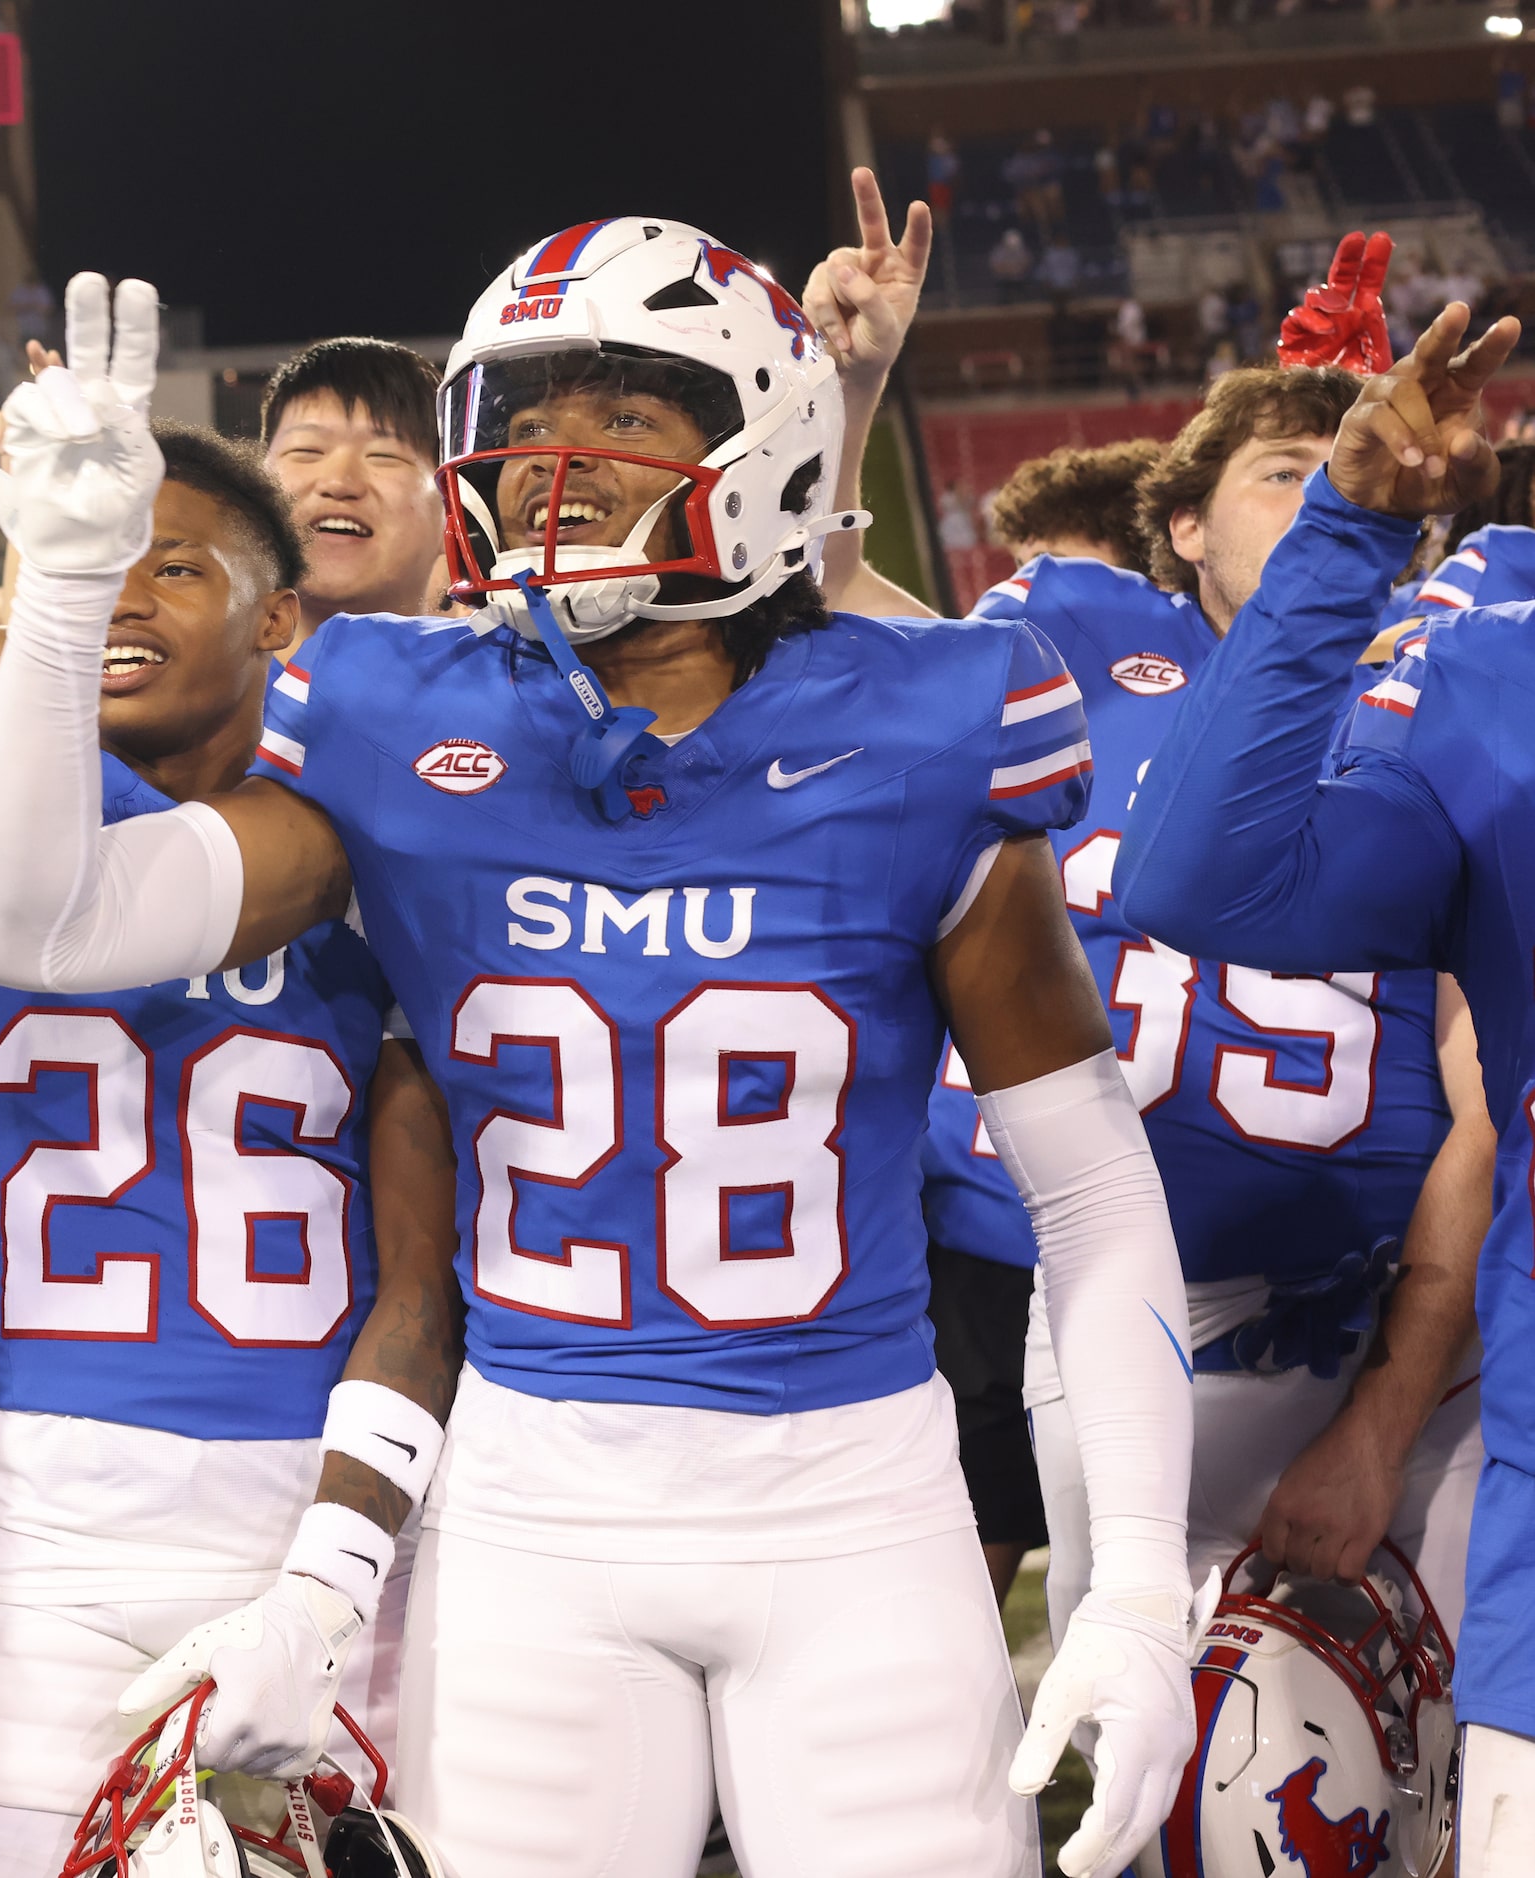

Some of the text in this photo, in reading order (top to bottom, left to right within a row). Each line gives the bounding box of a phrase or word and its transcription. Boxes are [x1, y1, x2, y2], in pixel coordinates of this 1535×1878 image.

[499, 298, 563, 325] SMU
[1120, 663, 1178, 682] ACC
[571, 672, 603, 719] BATTLE
[427, 753, 493, 773] ACC
[505, 876, 757, 959] SMU
[449, 973, 857, 1330] 28
[1205, 1623, 1263, 1645] SMU
